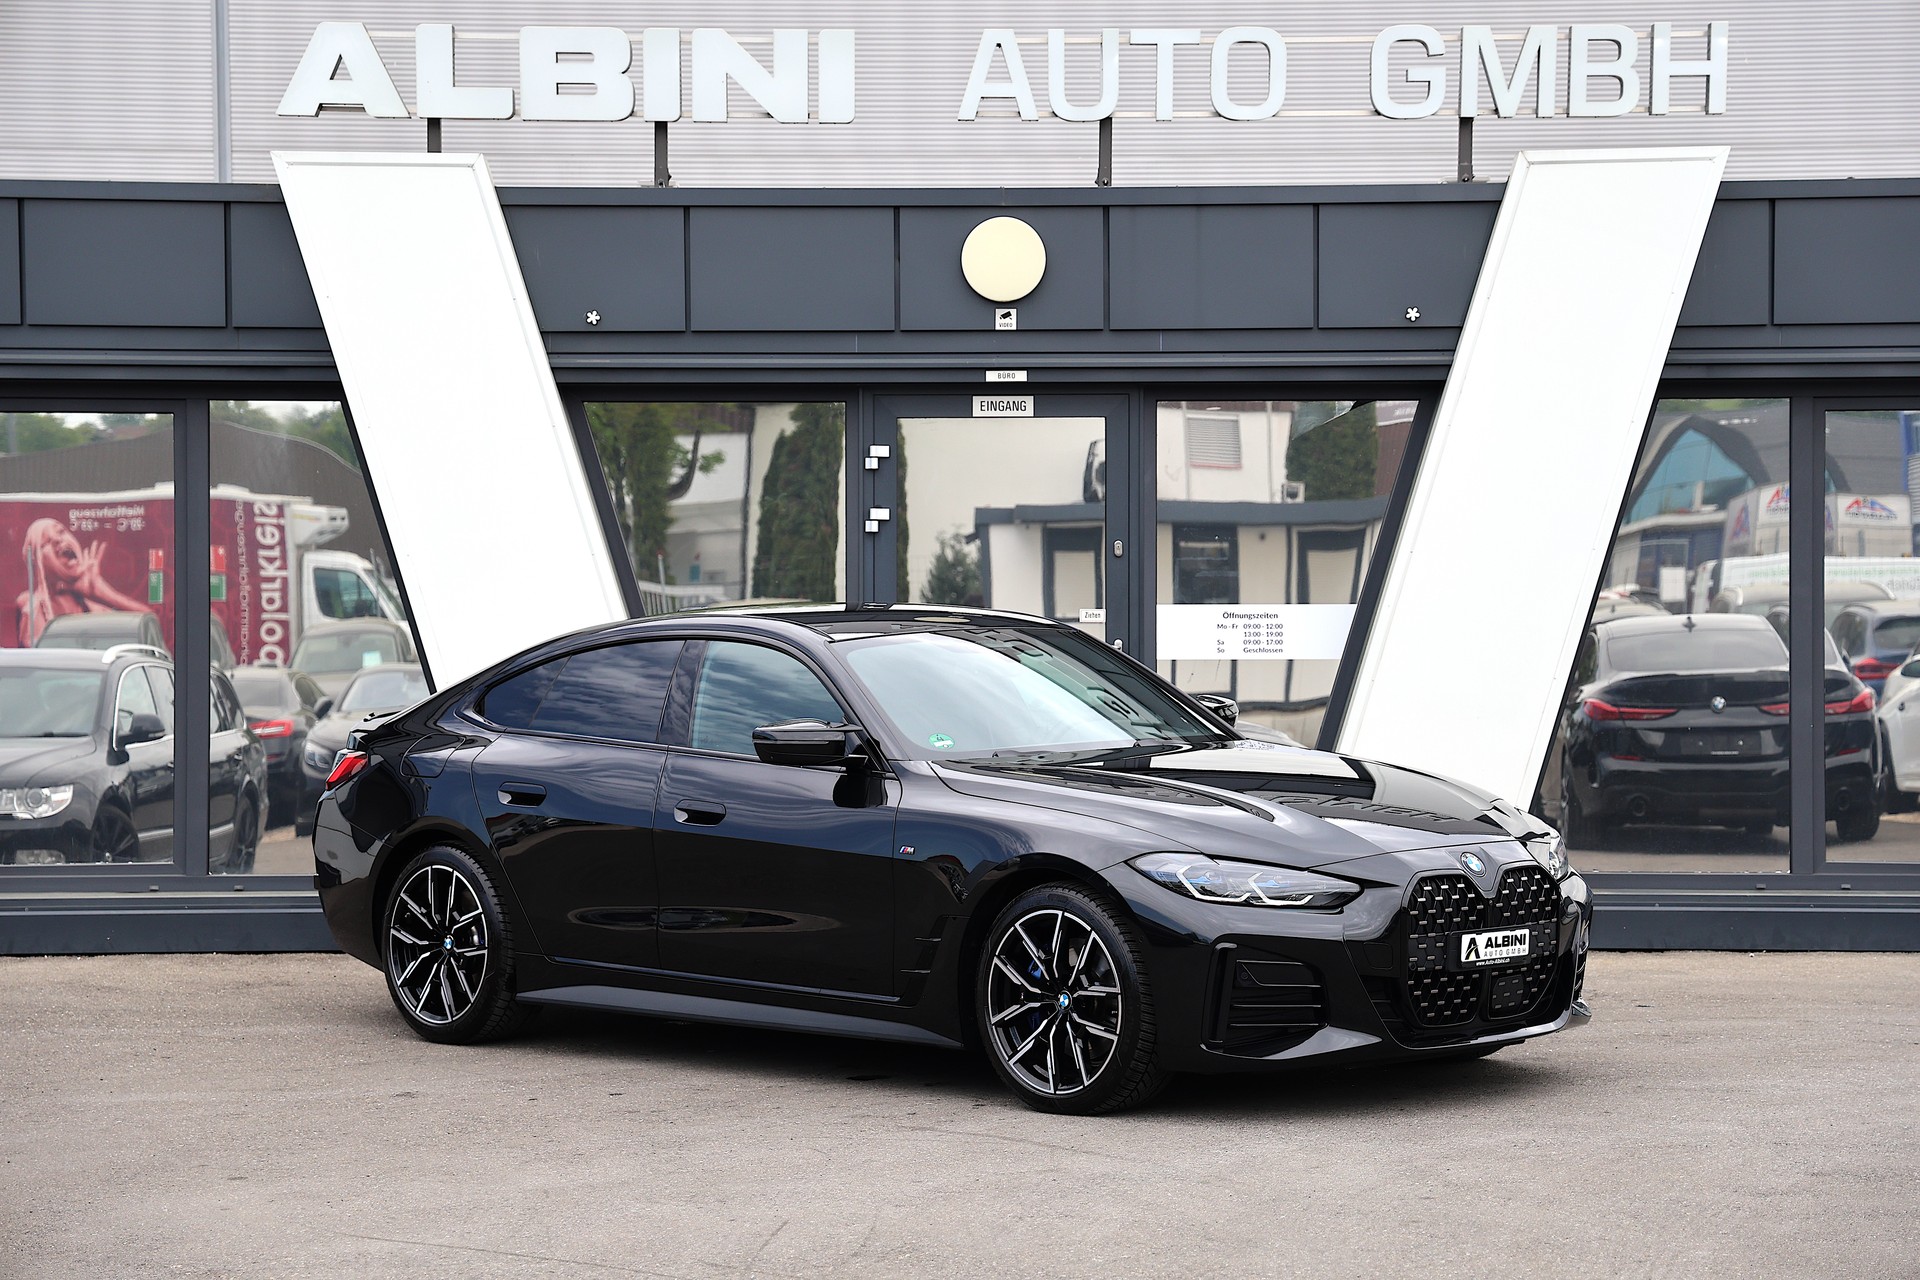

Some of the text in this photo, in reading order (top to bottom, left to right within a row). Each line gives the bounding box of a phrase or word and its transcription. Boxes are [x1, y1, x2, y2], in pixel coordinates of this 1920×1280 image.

[275, 20, 1729, 124] ALBINI AUTO GMBH
[997, 371, 1016, 379] BÜRO
[980, 400, 1027, 412] EINGANG
[1084, 611, 1101, 619] Ziehen
[1222, 611, 1279, 620] Öffnungszeiten
[1484, 933, 1526, 950] ALBINI
[1506, 947, 1527, 955] GMBH
